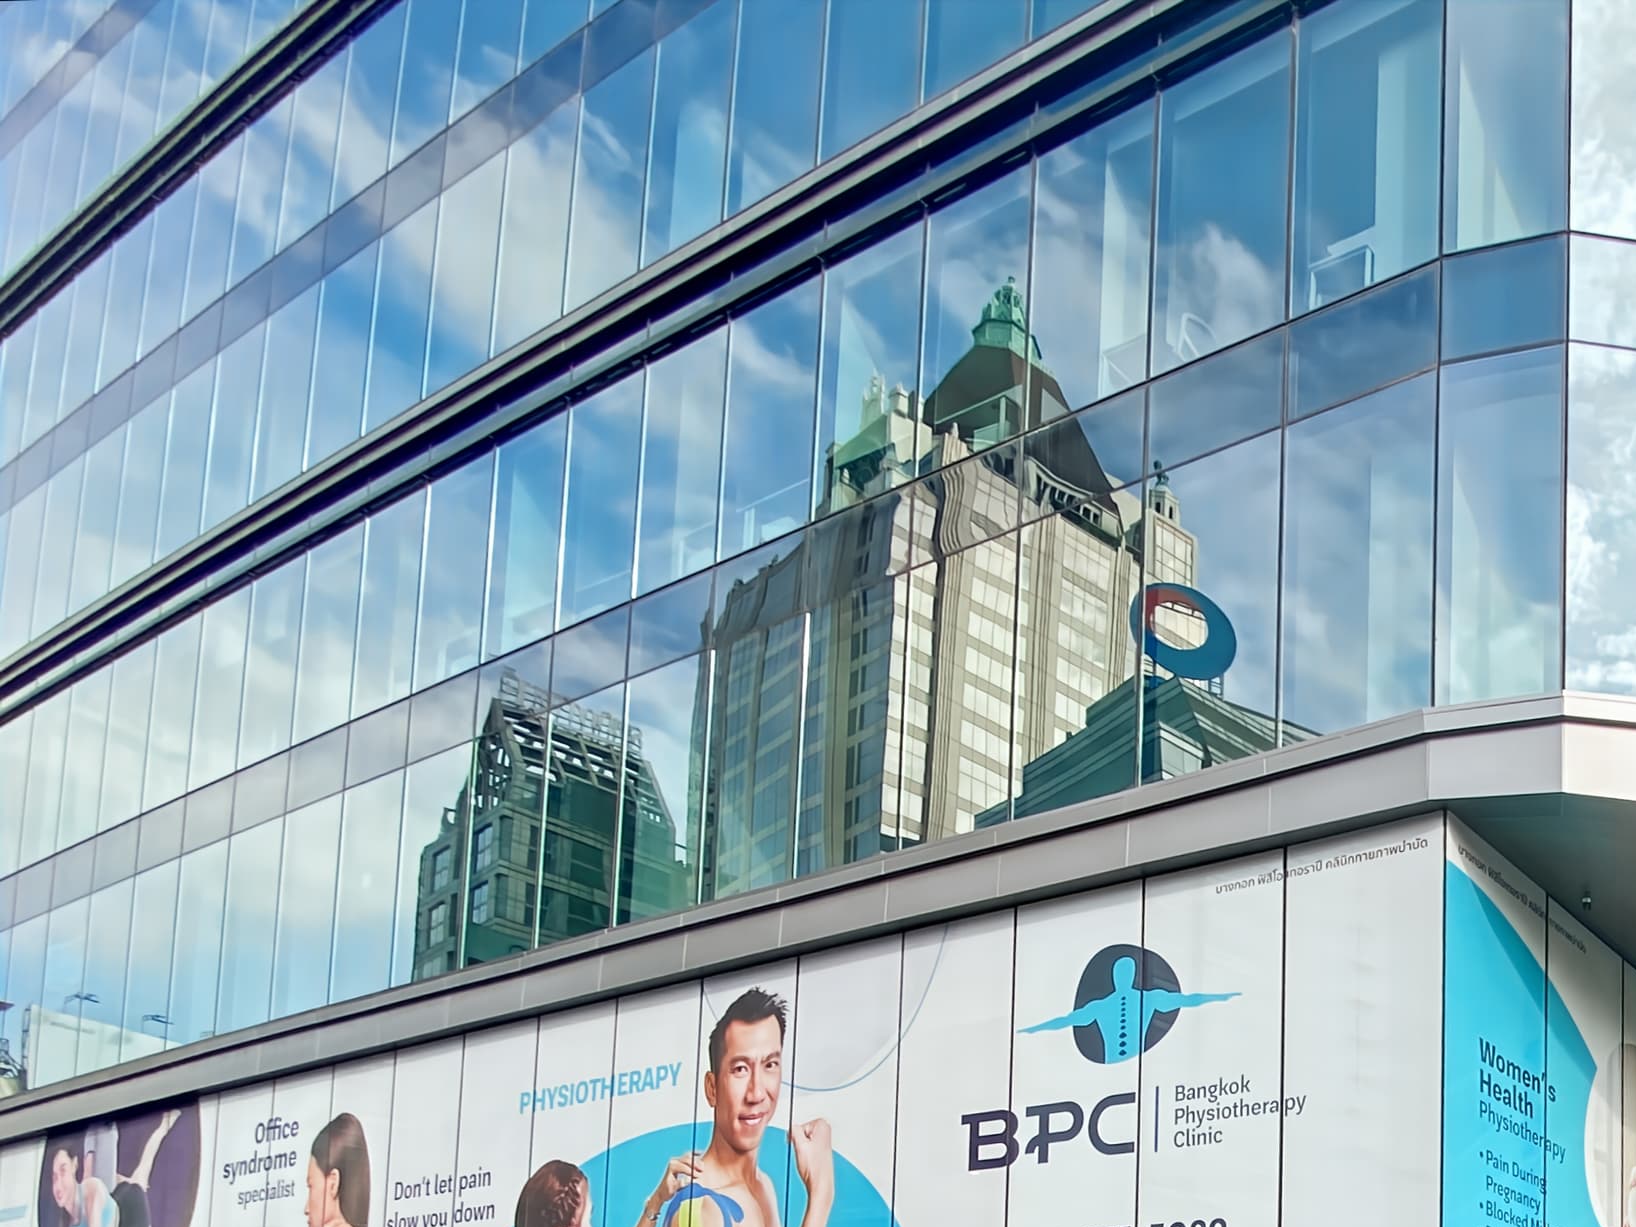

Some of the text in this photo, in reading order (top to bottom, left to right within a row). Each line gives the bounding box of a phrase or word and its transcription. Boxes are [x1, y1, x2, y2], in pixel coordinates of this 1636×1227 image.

[1479, 1036, 1556, 1102] Women's
[519, 1062, 682, 1114] PHYSIOTHERAPY
[1175, 1074, 1251, 1103] Bangkok
[1480, 1068, 1533, 1119] Health
[1174, 1093, 1307, 1128] Physiotherapy
[255, 1117, 299, 1144] Office
[961, 1092, 1136, 1171] BPC
[1174, 1127, 1223, 1148] Clinic
[1480, 1100, 1566, 1164] Physiotherapy
[223, 1150, 297, 1185] syndrome
[394, 1165, 491, 1200] Don't let pain
[1486, 1149, 1546, 1194] Pain During
[237, 1180, 295, 1210] specialist
[454, 1201, 495, 1223] down
[1486, 1175, 1541, 1215] Pregnancy
